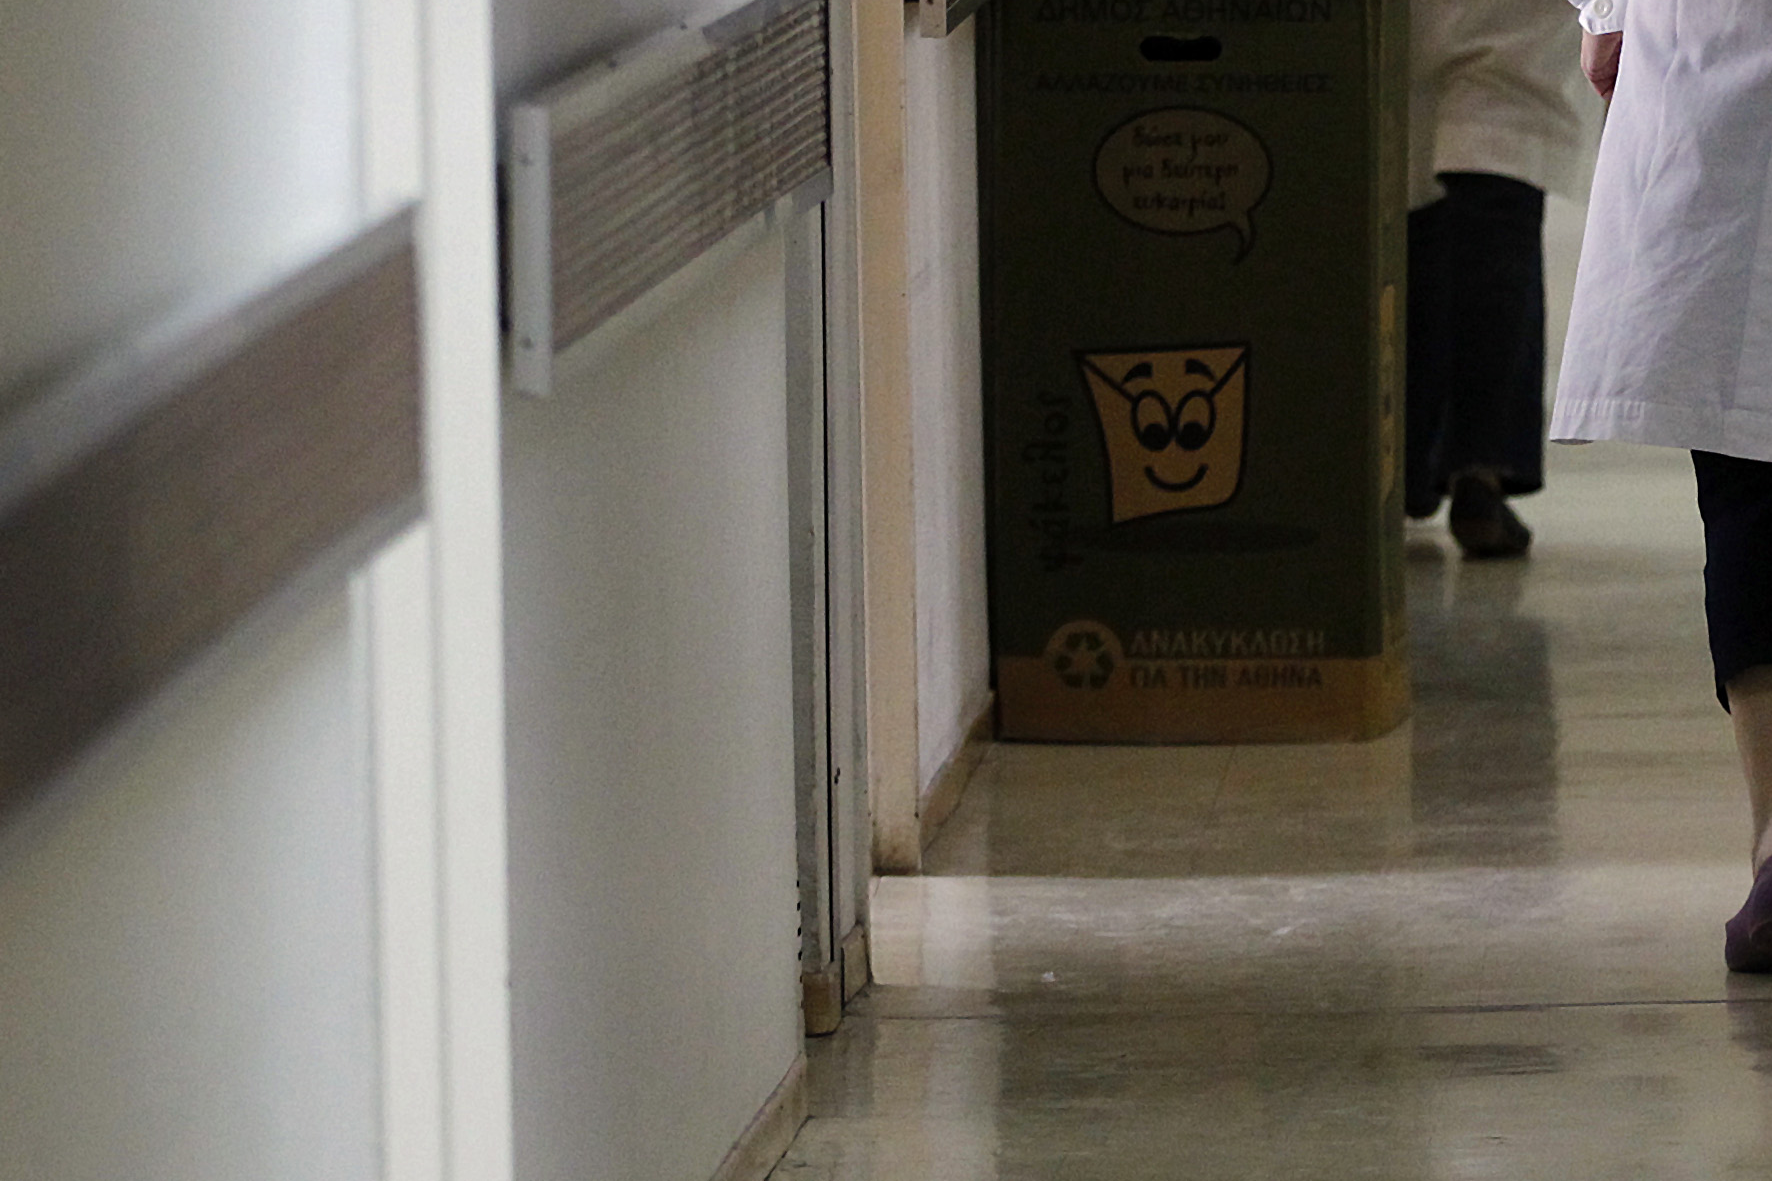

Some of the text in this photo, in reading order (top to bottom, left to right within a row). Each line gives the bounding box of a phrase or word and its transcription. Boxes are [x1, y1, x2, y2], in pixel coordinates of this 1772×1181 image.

[1130, 630, 1325, 656] ΑΝΑΚΥΚΛΩΣΗ
[1130, 665, 1323, 688] ΓΙΑ ΤΗΝ ΑΘΗΝΑ
